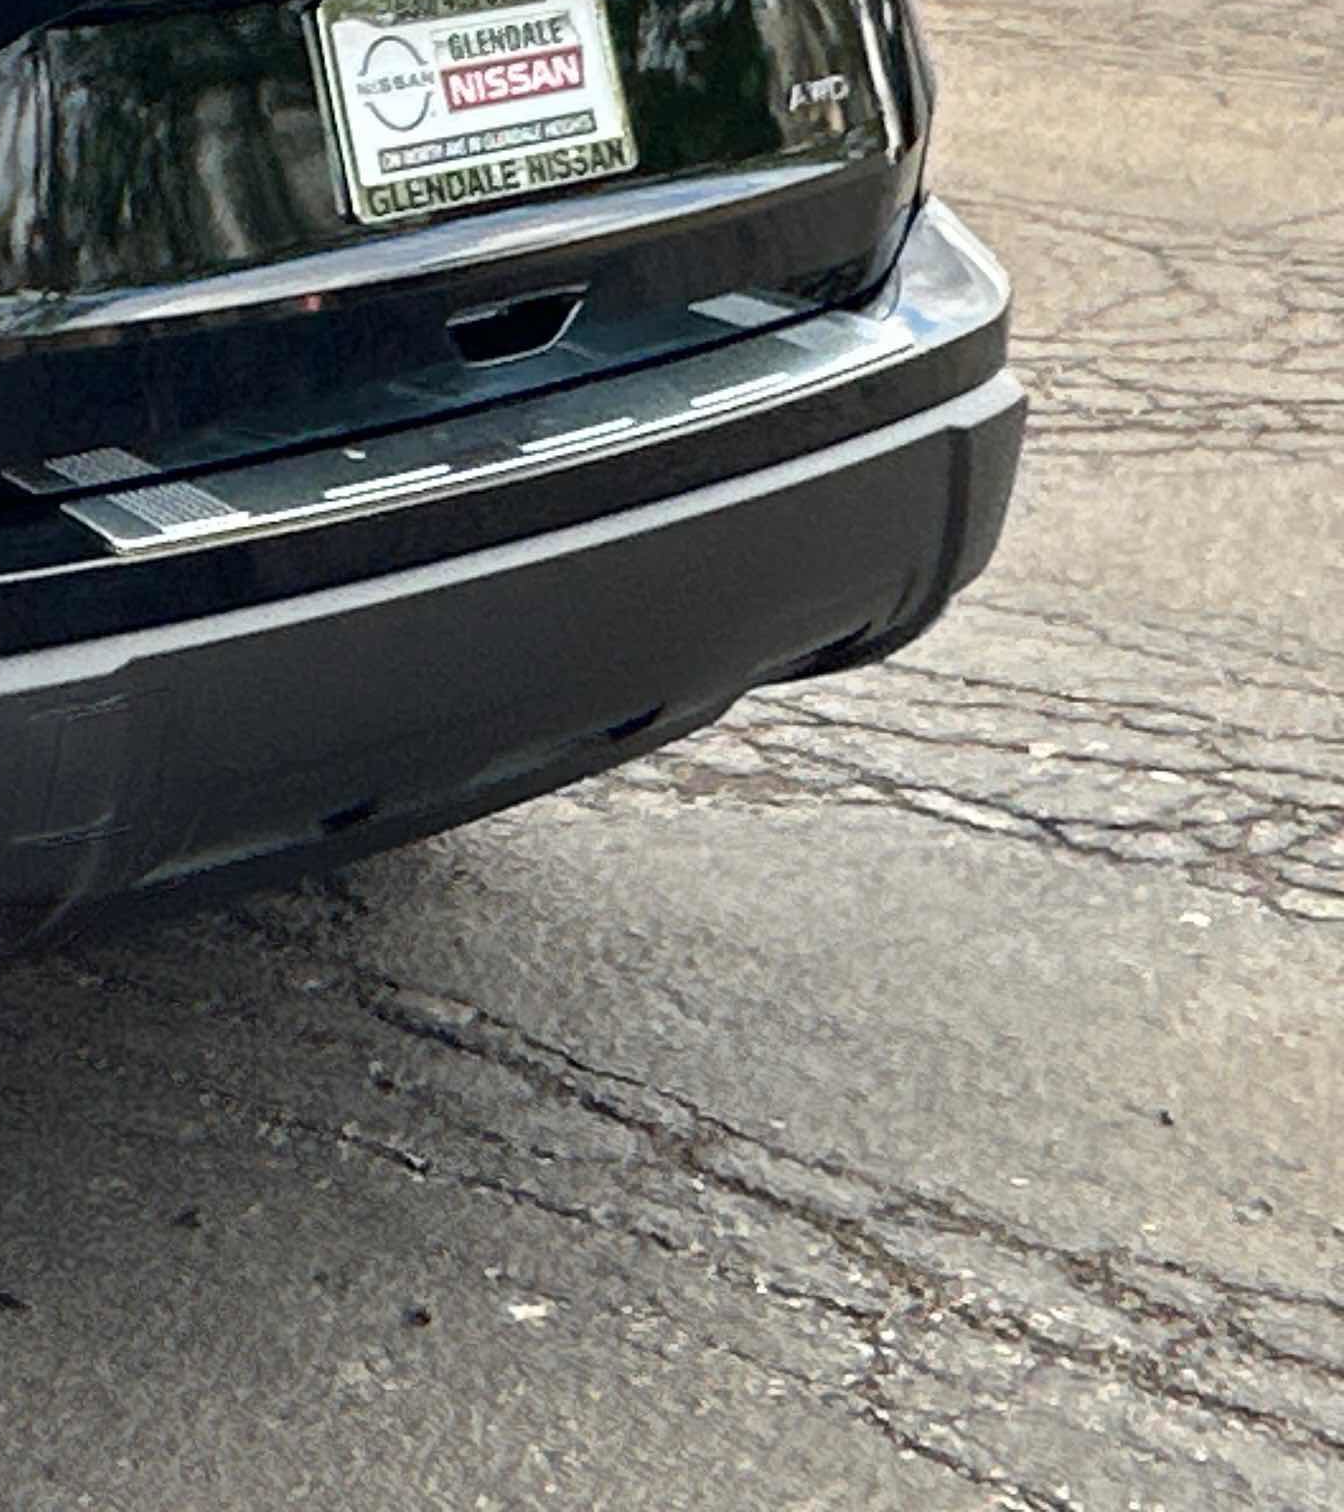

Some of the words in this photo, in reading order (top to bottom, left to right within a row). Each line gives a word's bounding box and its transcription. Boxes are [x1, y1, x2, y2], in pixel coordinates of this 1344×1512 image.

[448, 17, 564, 61] GLENDALE
[356, 72, 435, 95] NISSAN
[448, 53, 581, 106] NISSAN
[366, 159, 521, 217] GLENDALE
[525, 138, 627, 183] NISSAN
